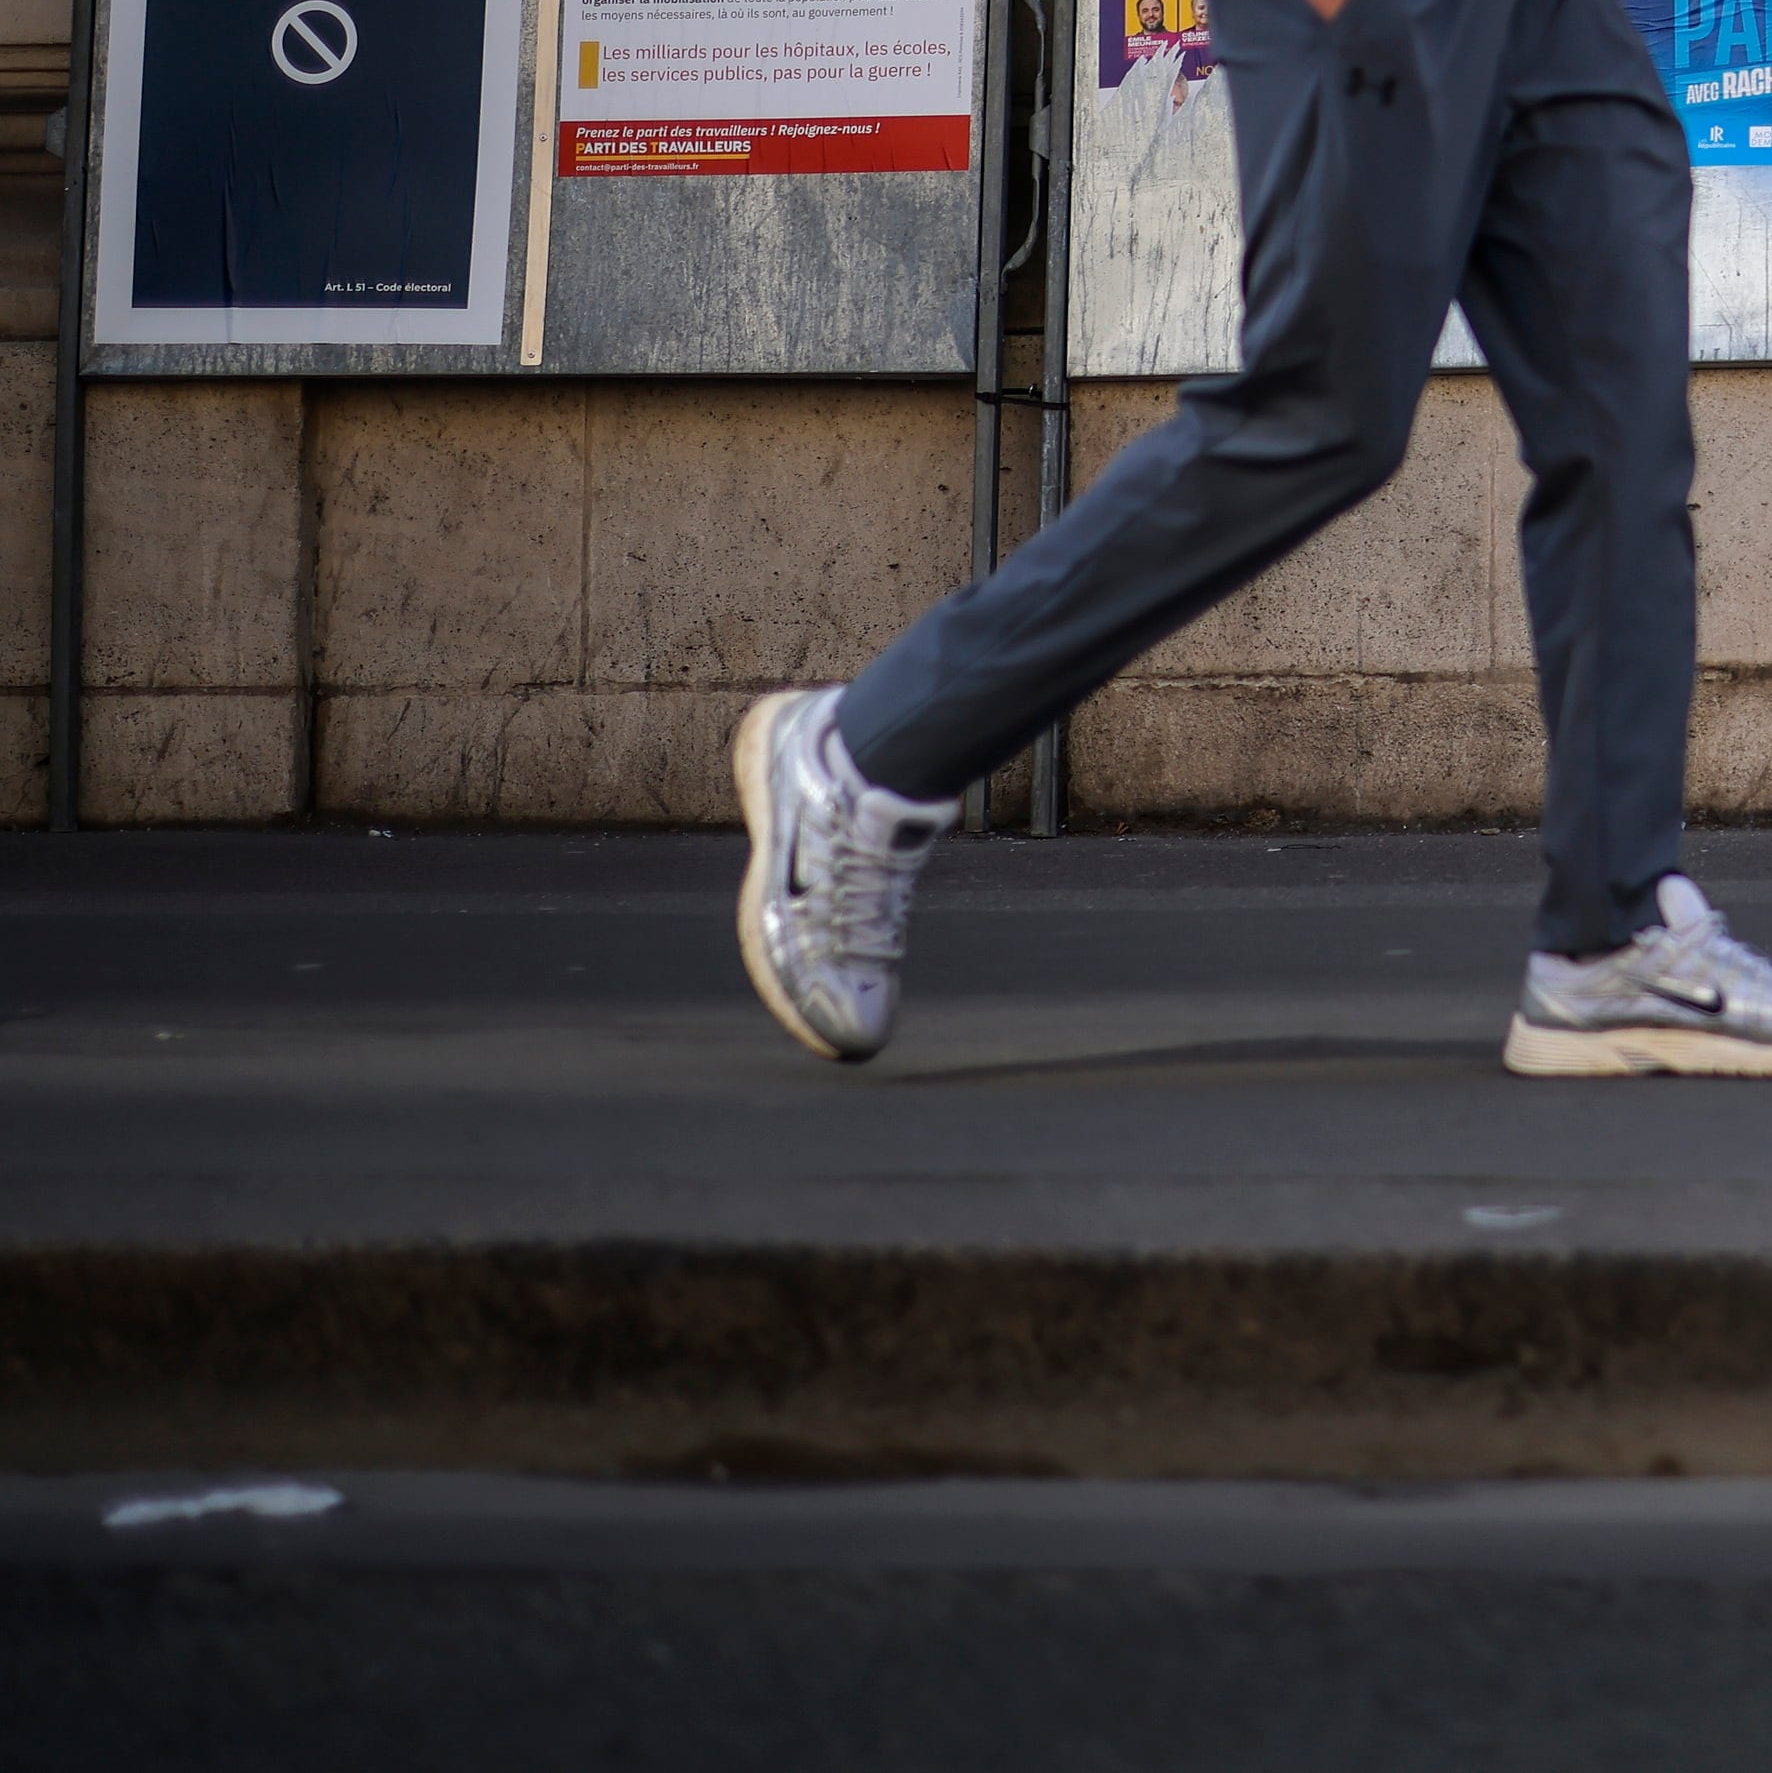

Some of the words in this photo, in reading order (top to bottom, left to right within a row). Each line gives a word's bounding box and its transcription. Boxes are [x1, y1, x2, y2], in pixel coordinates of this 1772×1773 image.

[604, 46, 630, 59] Les
[637, 44, 706, 59] milliards
[713, 48, 750, 61] pour
[756, 44, 777, 57] les
[784, 42, 858, 60] hôpitaux,
[866, 41, 888, 55] les
[893, 40, 950, 55] écoles,
[603, 68, 625, 82] les
[631, 67, 698, 81] services
[705, 66, 767, 84] publics,
[774, 69, 801, 83] pas
[808, 68, 844, 82] pour
[850, 64, 863, 77] la
[868, 66, 921, 81] guerre
[1686, 82, 1718, 104] AVEC
[576, 143, 615, 153] PARTI
[620, 142, 647, 153] DES
[651, 141, 751, 152] TRAVAILLEURS
[325, 283, 344, 291] Art.
[356, 283, 365, 291] 51
[376, 283, 402, 291] Code
[405, 283, 451, 291] électoral
